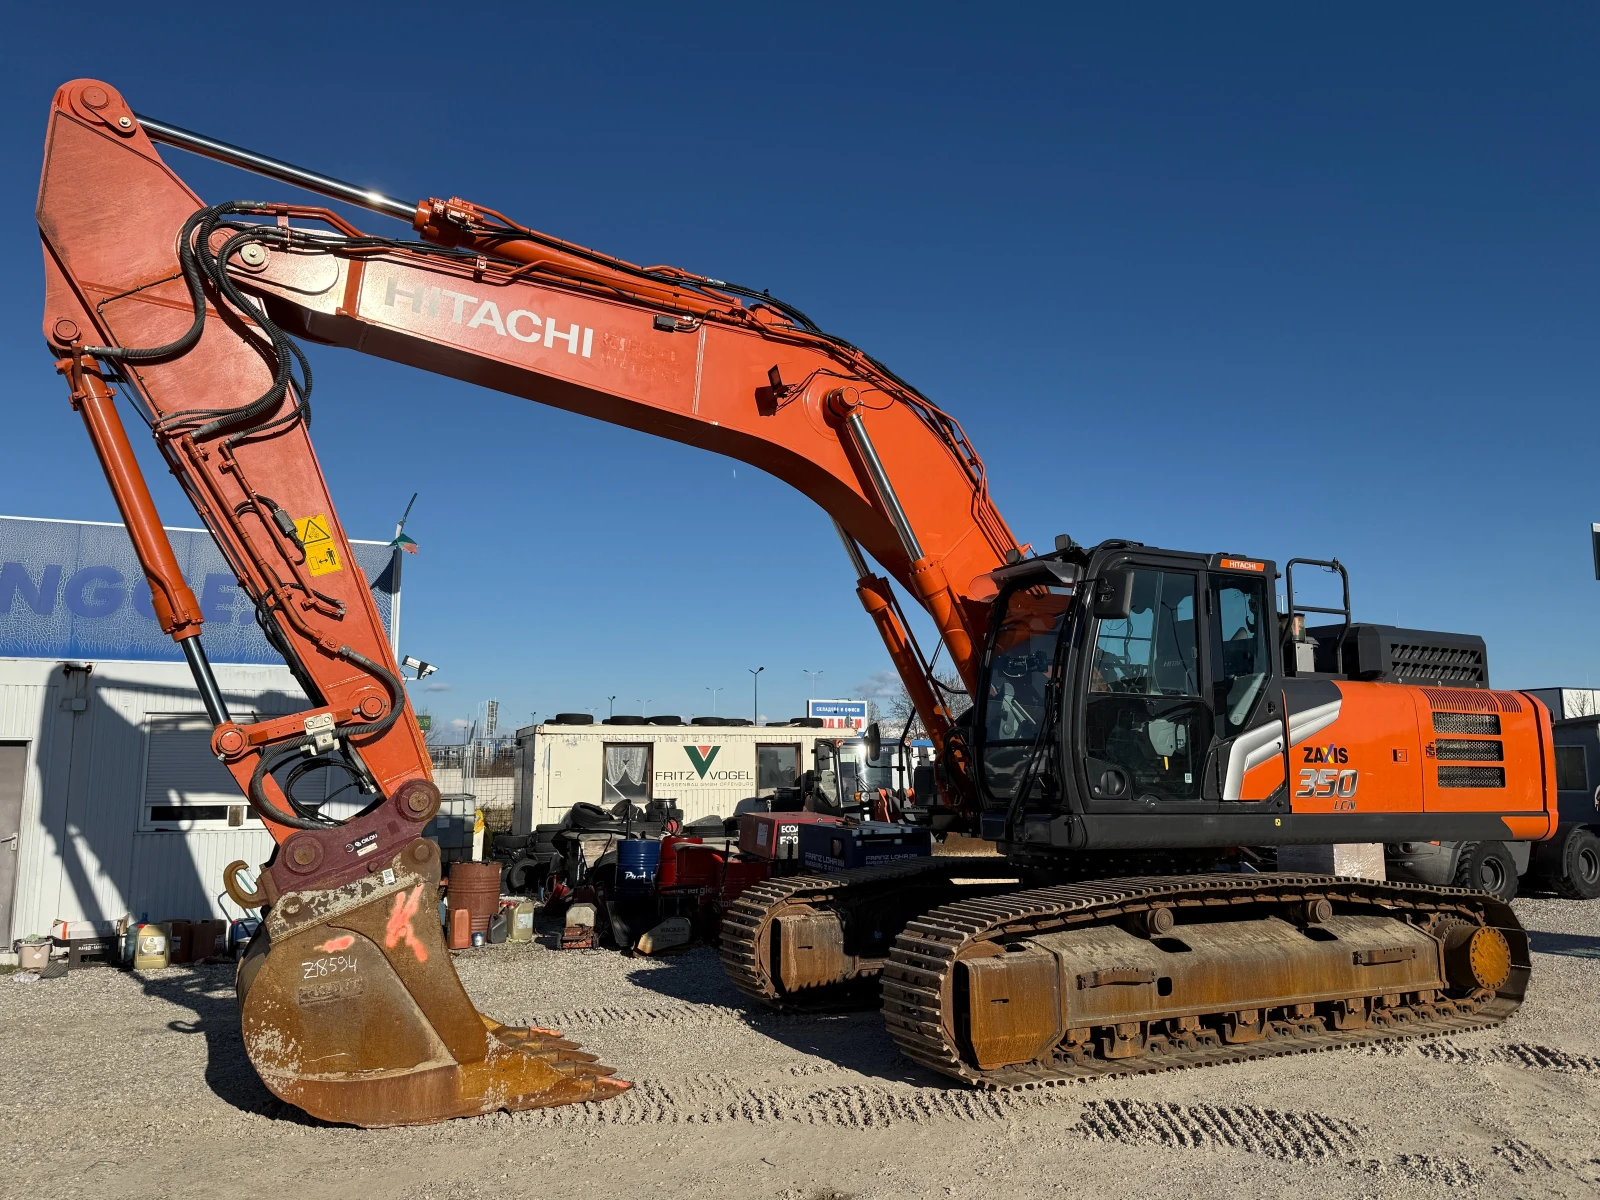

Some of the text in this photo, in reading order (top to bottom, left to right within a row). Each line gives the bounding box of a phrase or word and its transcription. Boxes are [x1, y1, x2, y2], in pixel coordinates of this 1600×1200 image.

[385, 276, 594, 358] HITACHI
[1229, 560, 1257, 570] HITACHI
[1303, 744, 1349, 764] ZAXIS
[655, 770, 754, 781] FRITZ VOGEL
[1296, 768, 1359, 798] 350
[1334, 800, 1357, 811] LCN
